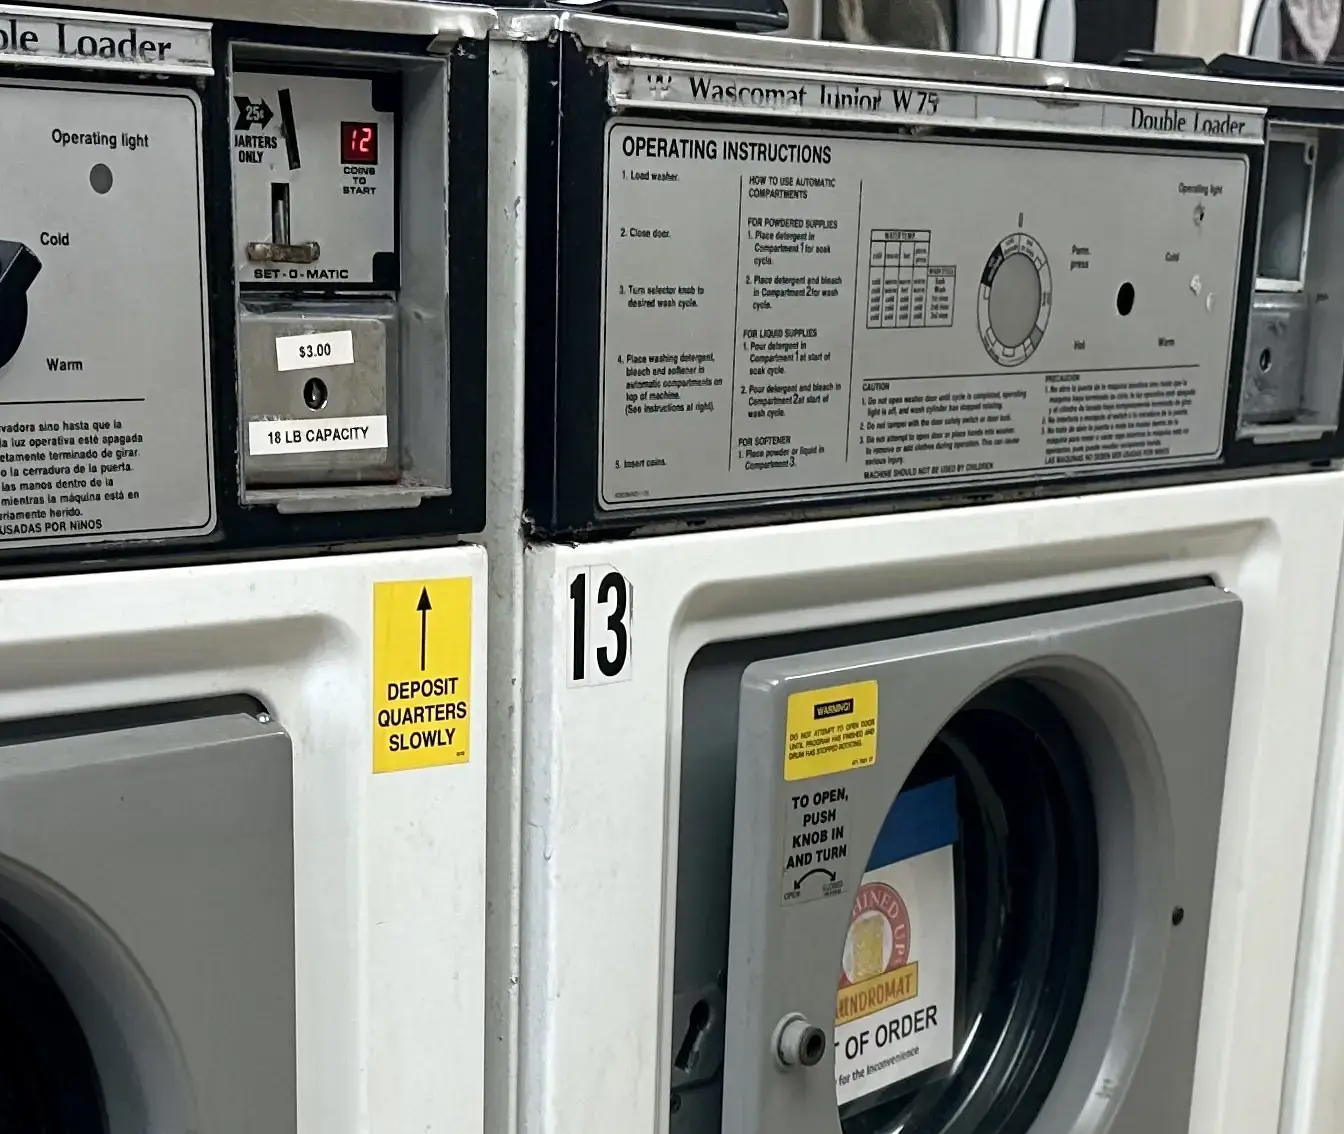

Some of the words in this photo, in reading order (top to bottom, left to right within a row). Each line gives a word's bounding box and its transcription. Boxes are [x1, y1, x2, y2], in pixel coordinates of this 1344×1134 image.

[57, 23, 172, 61] Loader
[689, 76, 807, 107] Wascomat
[1131, 107, 1186, 132] Double
[1194, 111, 1245, 134] Loader
[52, 129, 117, 149] Operating
[122, 131, 149, 150] light
[352, 128, 372, 152] 12
[622, 135, 717, 159] OPERATING
[723, 140, 832, 164] INSTRUCTIONS
[239, 151, 263, 163] ONLY
[343, 187, 376, 195] START
[353, 177, 366, 185] TO
[40, 231, 70, 246] Cold
[299, 343, 331, 358] $3.00
[46, 357, 83, 372] Warm
[268, 431, 281, 444] 18
[285, 431, 301, 443] LB
[306, 426, 369, 442] CAPACITY
[570, 572, 627, 680] 13
[388, 677, 458, 700] DEPOSIT
[378, 701, 466, 727] QUARTERS
[389, 728, 455, 751] SLOWLY
[792, 795, 809, 809] TO
[813, 788, 848, 805] OPEN,
[803, 809, 836, 827] PUSH
[792, 829, 827, 848] KNOB
[832, 826, 844, 840] IN
[787, 853, 812, 869] AND
[816, 844, 846, 862] TURN
[845, 1030, 870, 1059] OF
[875, 1005, 938, 1047] ORDER
[839, 1072, 851, 1086] for
[852, 1067, 865, 1080] the
